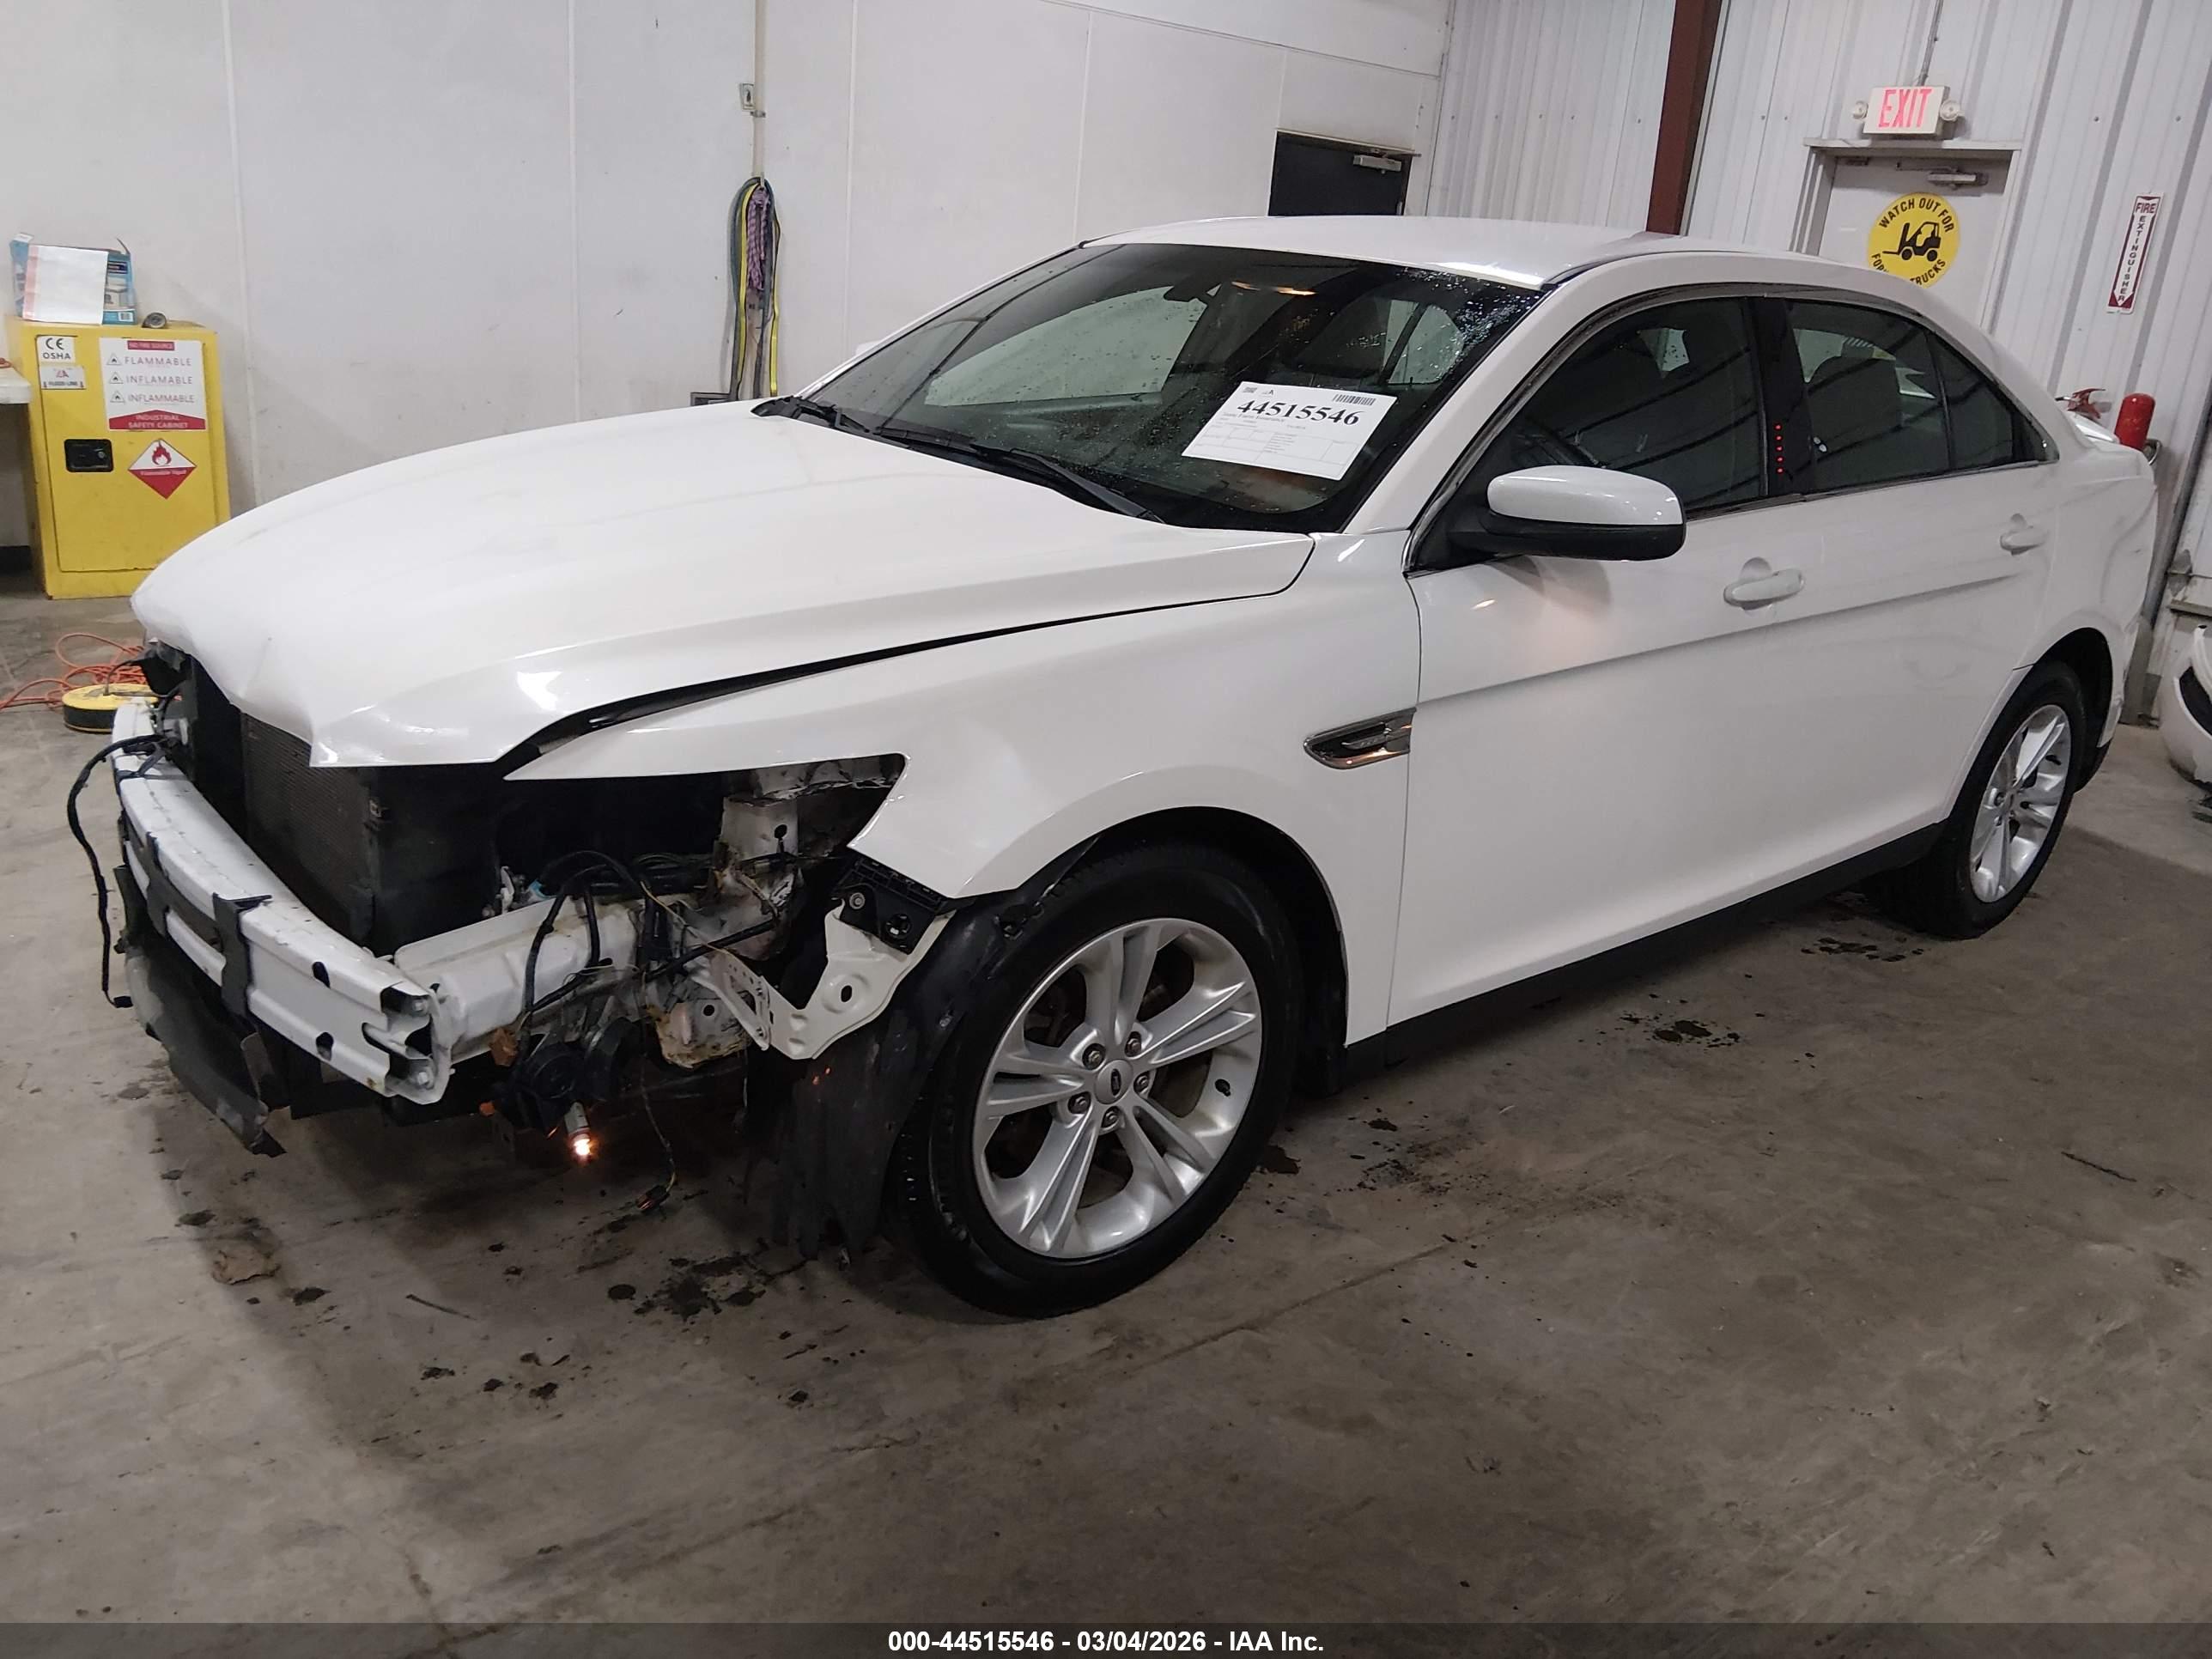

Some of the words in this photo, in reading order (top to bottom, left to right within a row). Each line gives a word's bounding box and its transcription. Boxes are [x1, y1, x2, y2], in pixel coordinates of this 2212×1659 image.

[1878, 88, 1932, 128] EXIT
[1879, 198, 1915, 228] WATCH
[1918, 198, 1941, 212] OUT
[1937, 209, 1954, 233] FOR
[2135, 203, 2157, 214] FIRE
[1871, 253, 1889, 272] FOR
[2118, 216, 2147, 301] EXTINGUISHER
[46, 337, 64, 350] CE
[125, 356, 192, 367] FLAMMABLE
[125, 375, 193, 385] INFLAMABLE
[127, 394, 195, 404] INFLAMMABLE
[1237, 400, 1365, 425] 44515546
